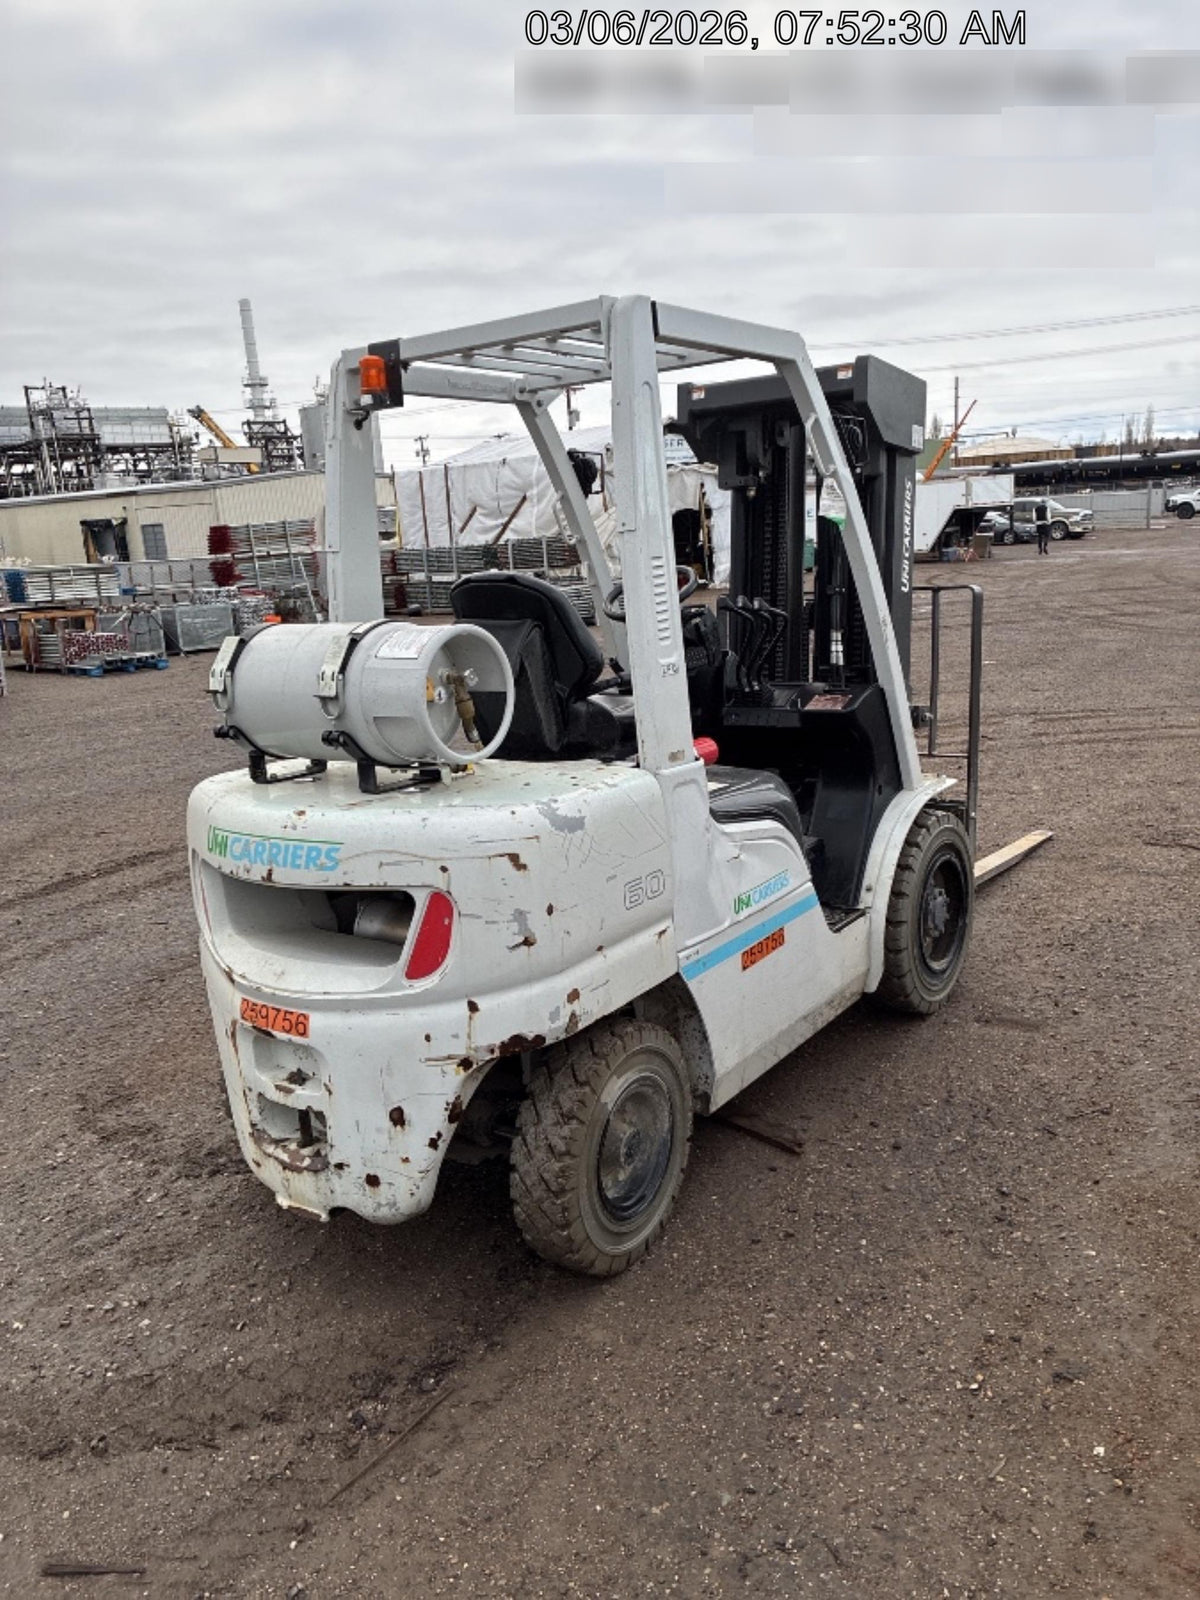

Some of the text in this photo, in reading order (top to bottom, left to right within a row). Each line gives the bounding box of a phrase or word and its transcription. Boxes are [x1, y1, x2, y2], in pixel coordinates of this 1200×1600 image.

[207, 824, 344, 872] UNICARRIERS
[623, 868, 667, 911] 60
[240, 997, 308, 1037] 259756
